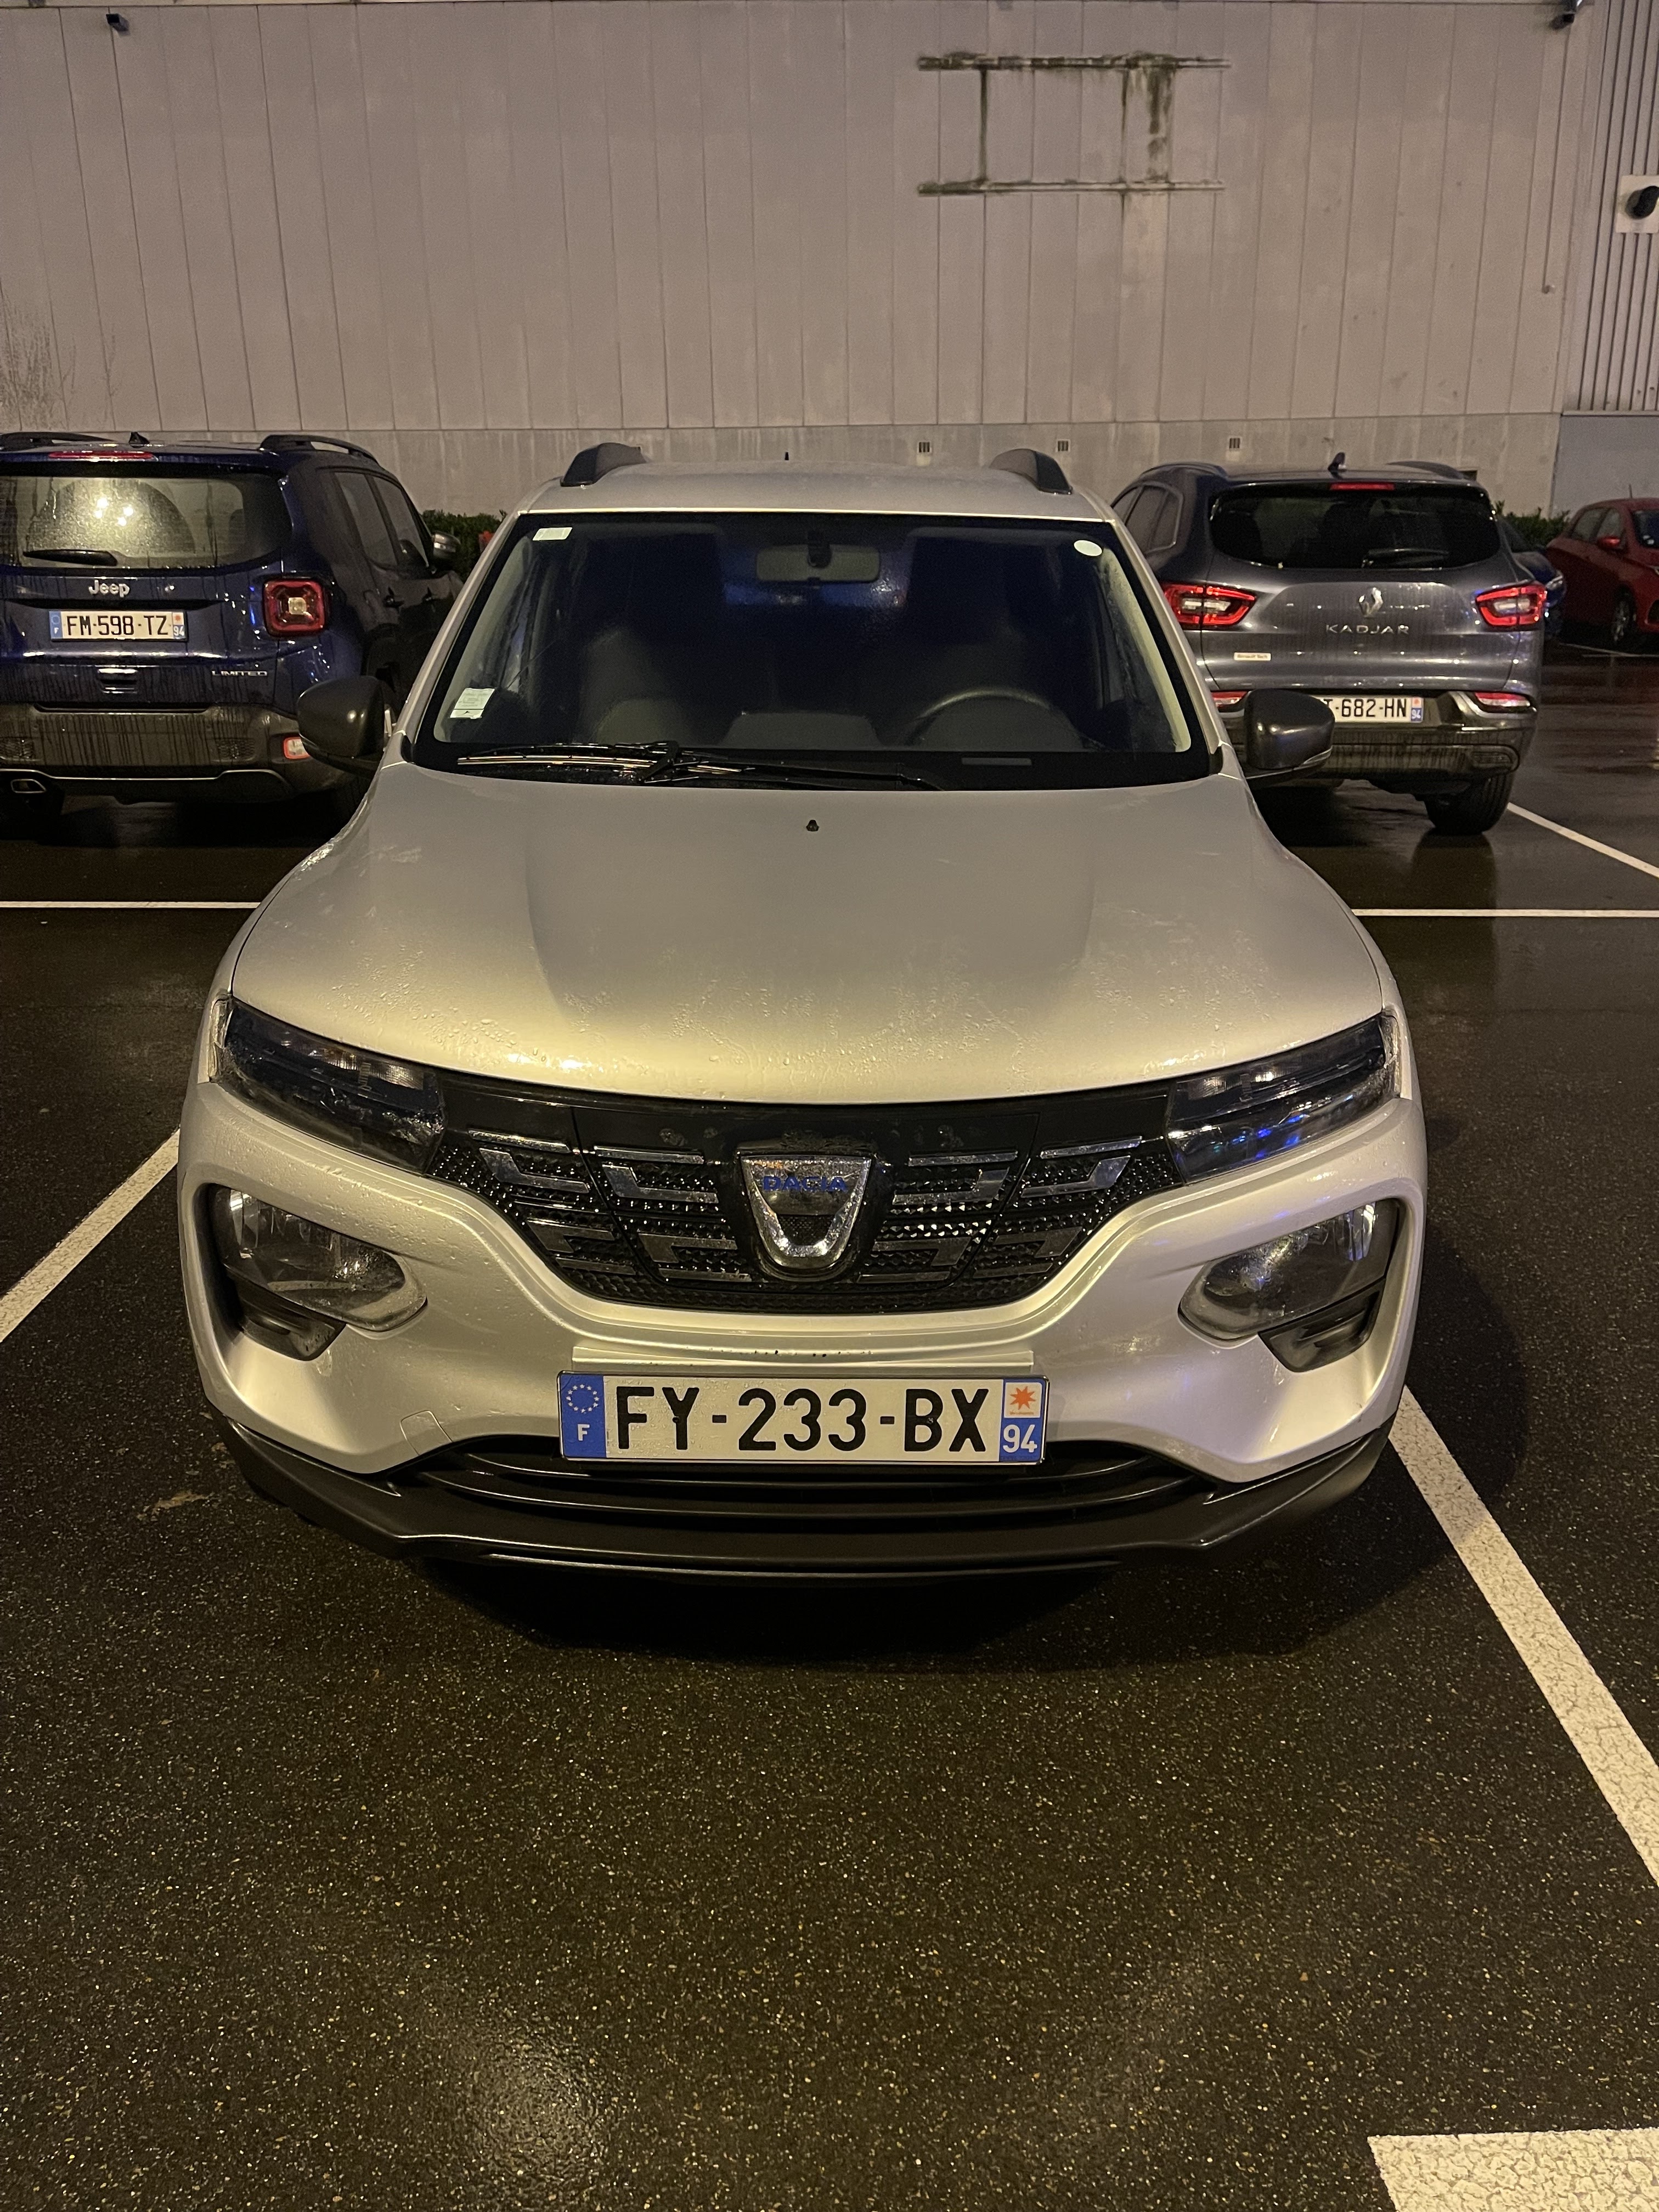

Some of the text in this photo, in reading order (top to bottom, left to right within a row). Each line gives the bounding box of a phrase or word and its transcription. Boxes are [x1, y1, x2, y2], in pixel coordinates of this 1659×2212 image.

[88, 579, 130, 597] Jeep
[66, 615, 168, 635] FM-598-TZ
[173, 626, 185, 636] 94
[1325, 624, 1409, 635] KADJAR
[1323, 698, 1407, 718] T-682-HN
[763, 1175, 849, 1192] DACIA
[616, 1385, 989, 1453] FY-233-BX
[577, 1423, 590, 1441] F
[1003, 1424, 1038, 1453] 94
